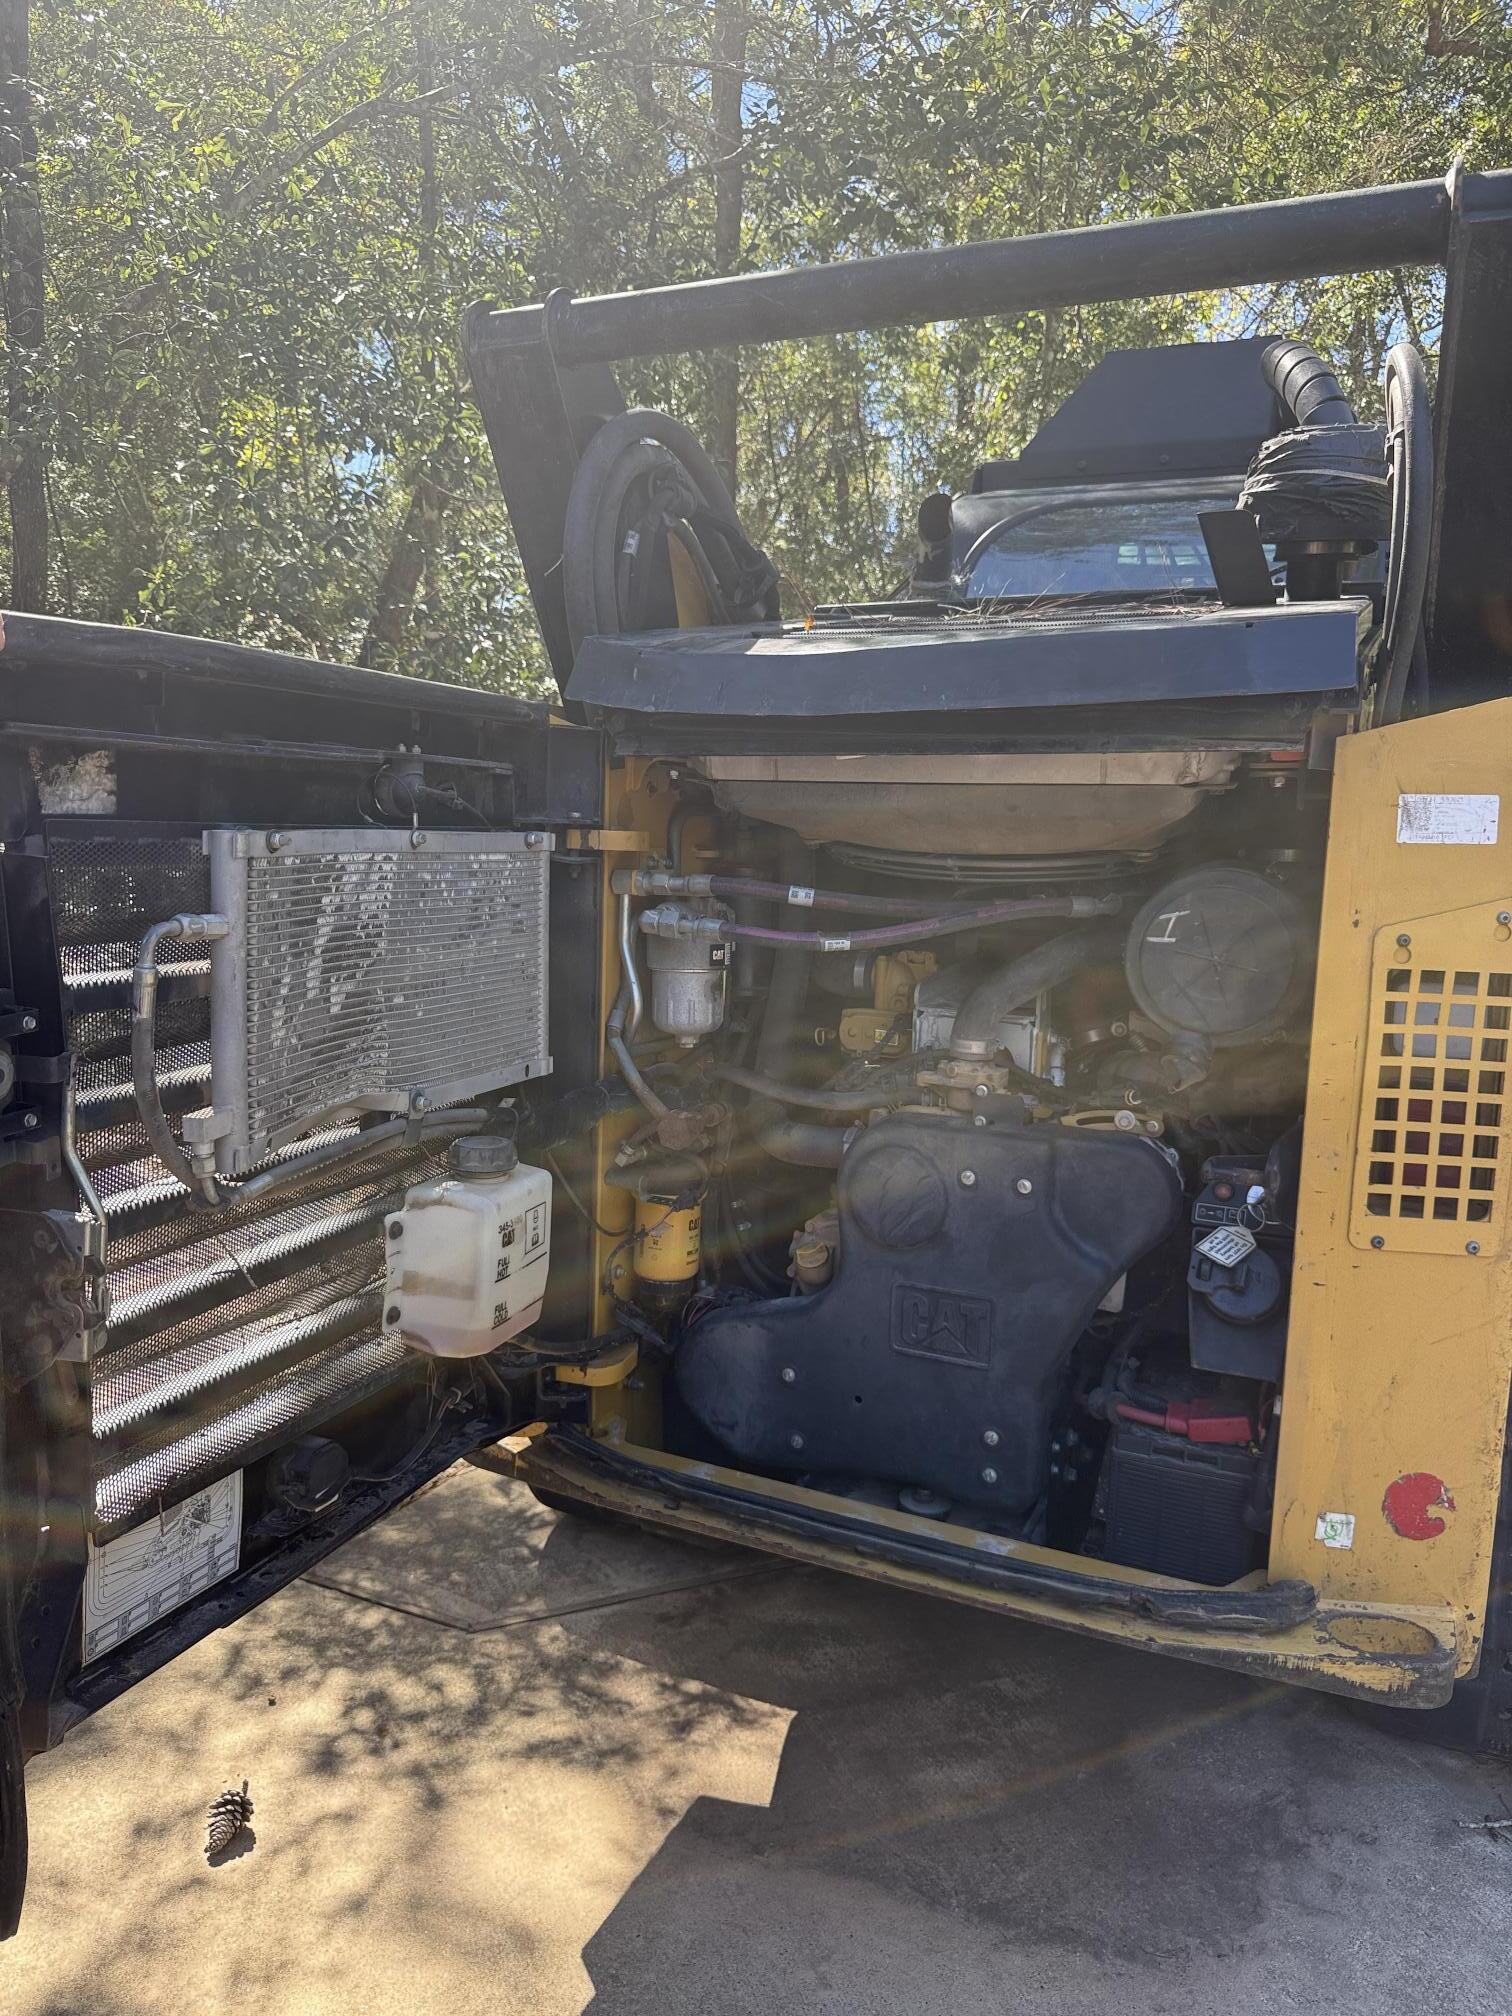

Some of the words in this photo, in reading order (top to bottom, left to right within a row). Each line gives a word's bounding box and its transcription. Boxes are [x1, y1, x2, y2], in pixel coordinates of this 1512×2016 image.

[712, 949, 724, 960] CAT
[498, 1213, 524, 1235] 345-3
[502, 1228, 515, 1248] CAT
[498, 1254, 510, 1269] FULL
[497, 1265, 509, 1279] HOT
[495, 1301, 507, 1315] FULL
[493, 1311, 508, 1325] COLD
[901, 1292, 988, 1359] CAT
